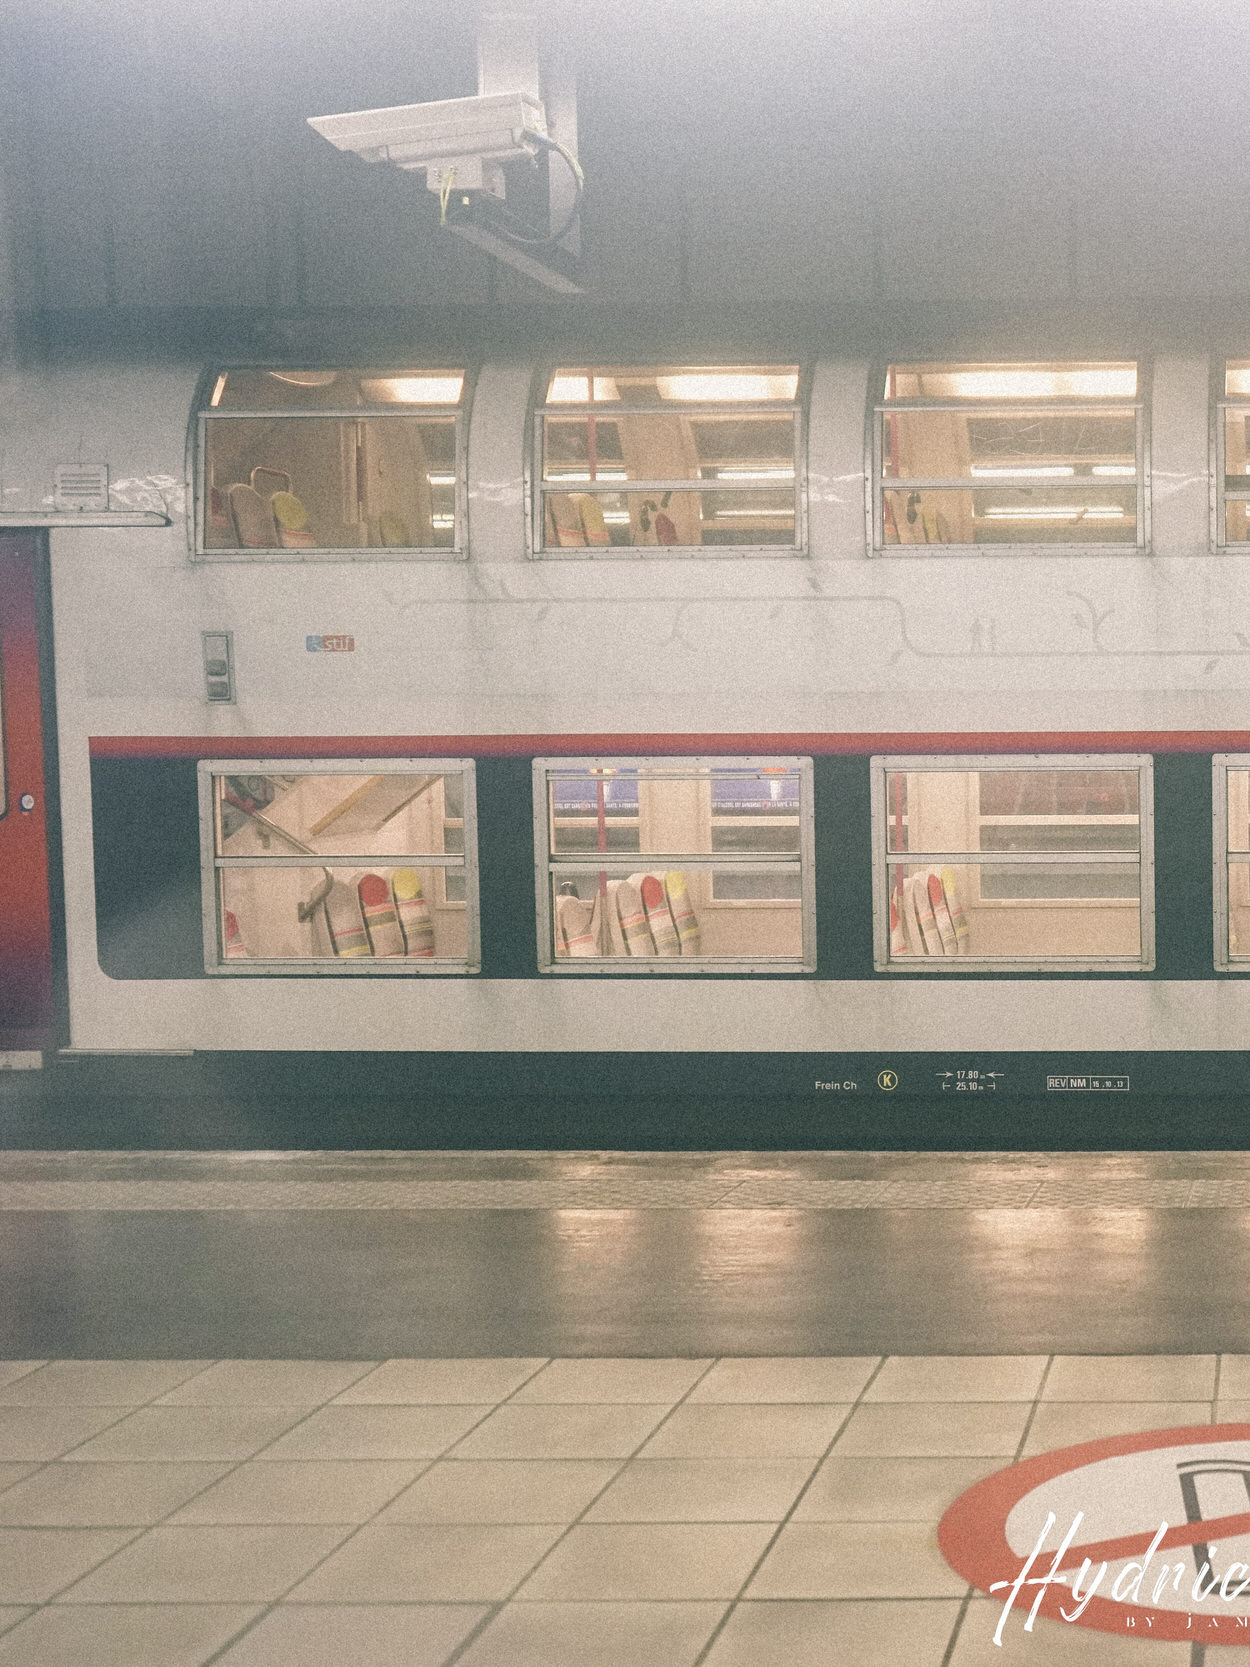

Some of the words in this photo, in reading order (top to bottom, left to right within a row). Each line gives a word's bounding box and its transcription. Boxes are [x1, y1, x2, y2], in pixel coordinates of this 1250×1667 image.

[324, 636, 352, 650] stif
[956, 1070, 979, 1079] 17.80
[815, 1081, 840, 1090] Frein
[843, 1081, 857, 1090] Ch
[956, 1081, 978, 1091] 25.10
[1049, 1078, 1067, 1088] REV
[1070, 1078, 1086, 1088] NM
